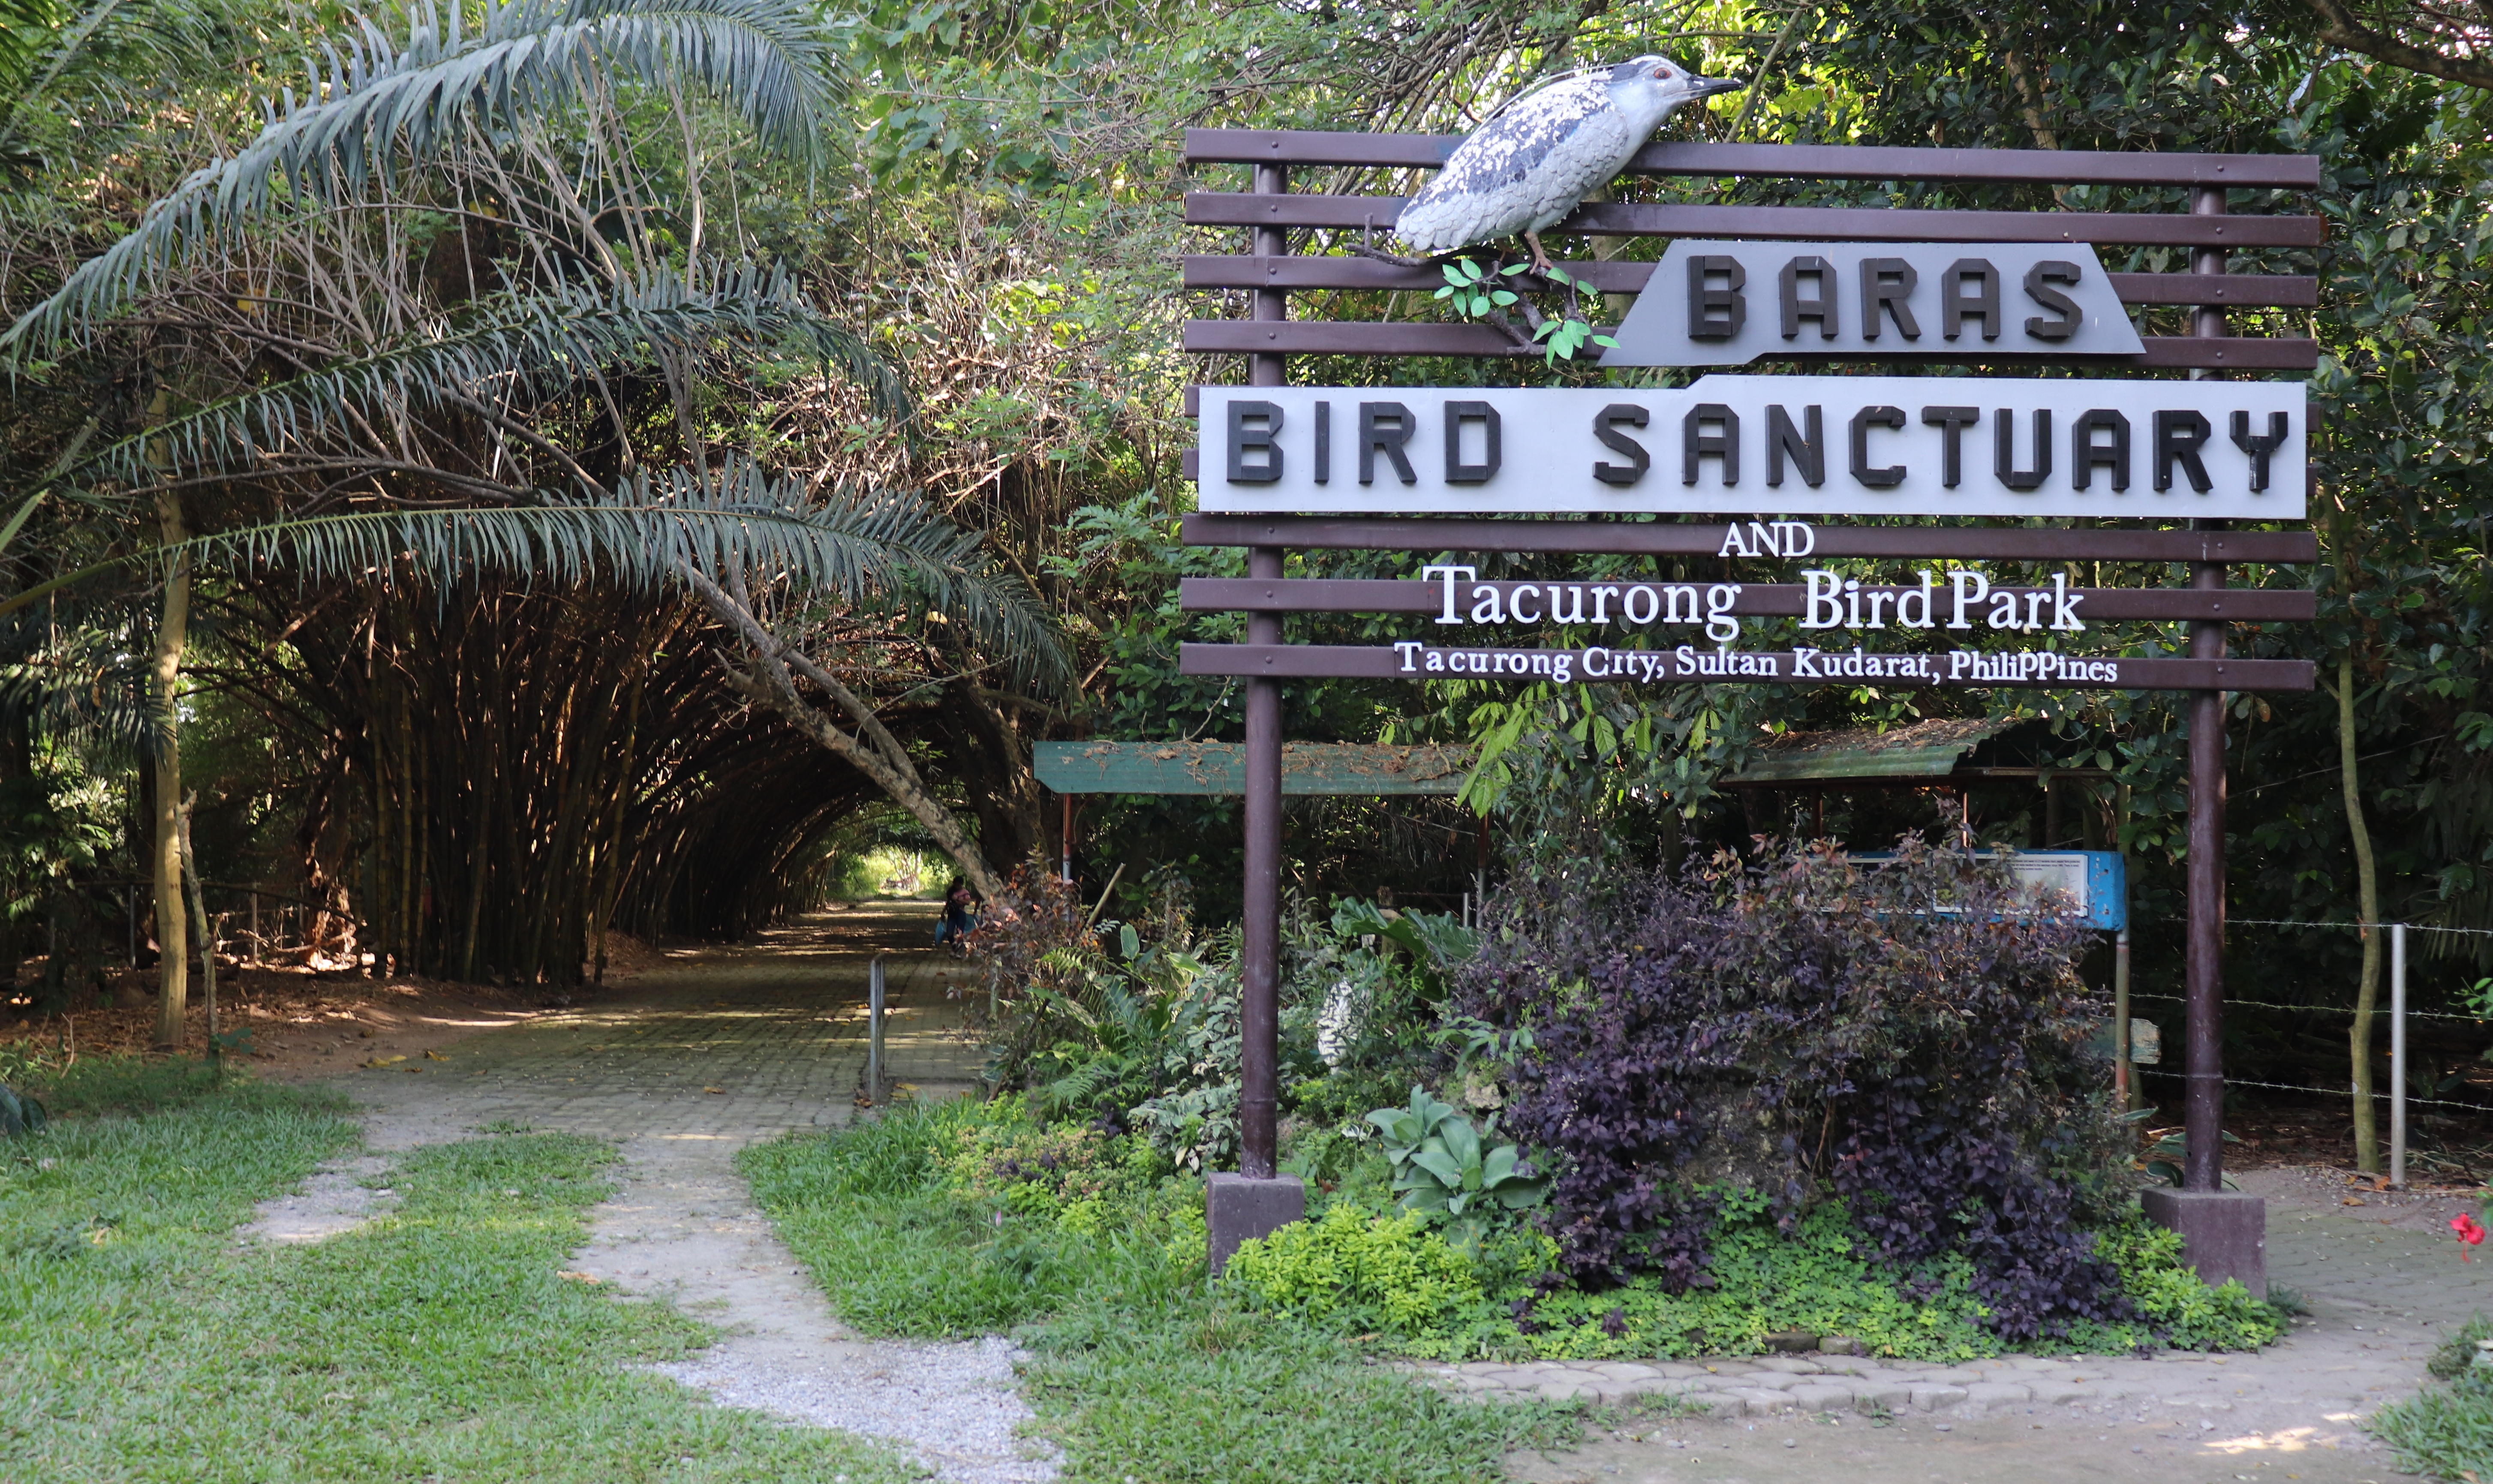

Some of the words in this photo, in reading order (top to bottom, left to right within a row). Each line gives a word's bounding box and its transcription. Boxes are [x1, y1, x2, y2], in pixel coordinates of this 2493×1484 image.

[1687, 255, 2083, 339] BARAS
[1227, 400, 1502, 484] BIRD
[1592, 403, 2288, 492] SANCTUARY
[1718, 522, 1814, 558] AND
[1422, 565, 1742, 642] Tacurong
[1799, 570, 1936, 629] Bird
[1946, 571, 2086, 631] Park
[1394, 642, 1573, 684] Tacurong
[1675, 646, 1778, 677] Sultan
[1791, 647, 1941, 685] Kudarat,
